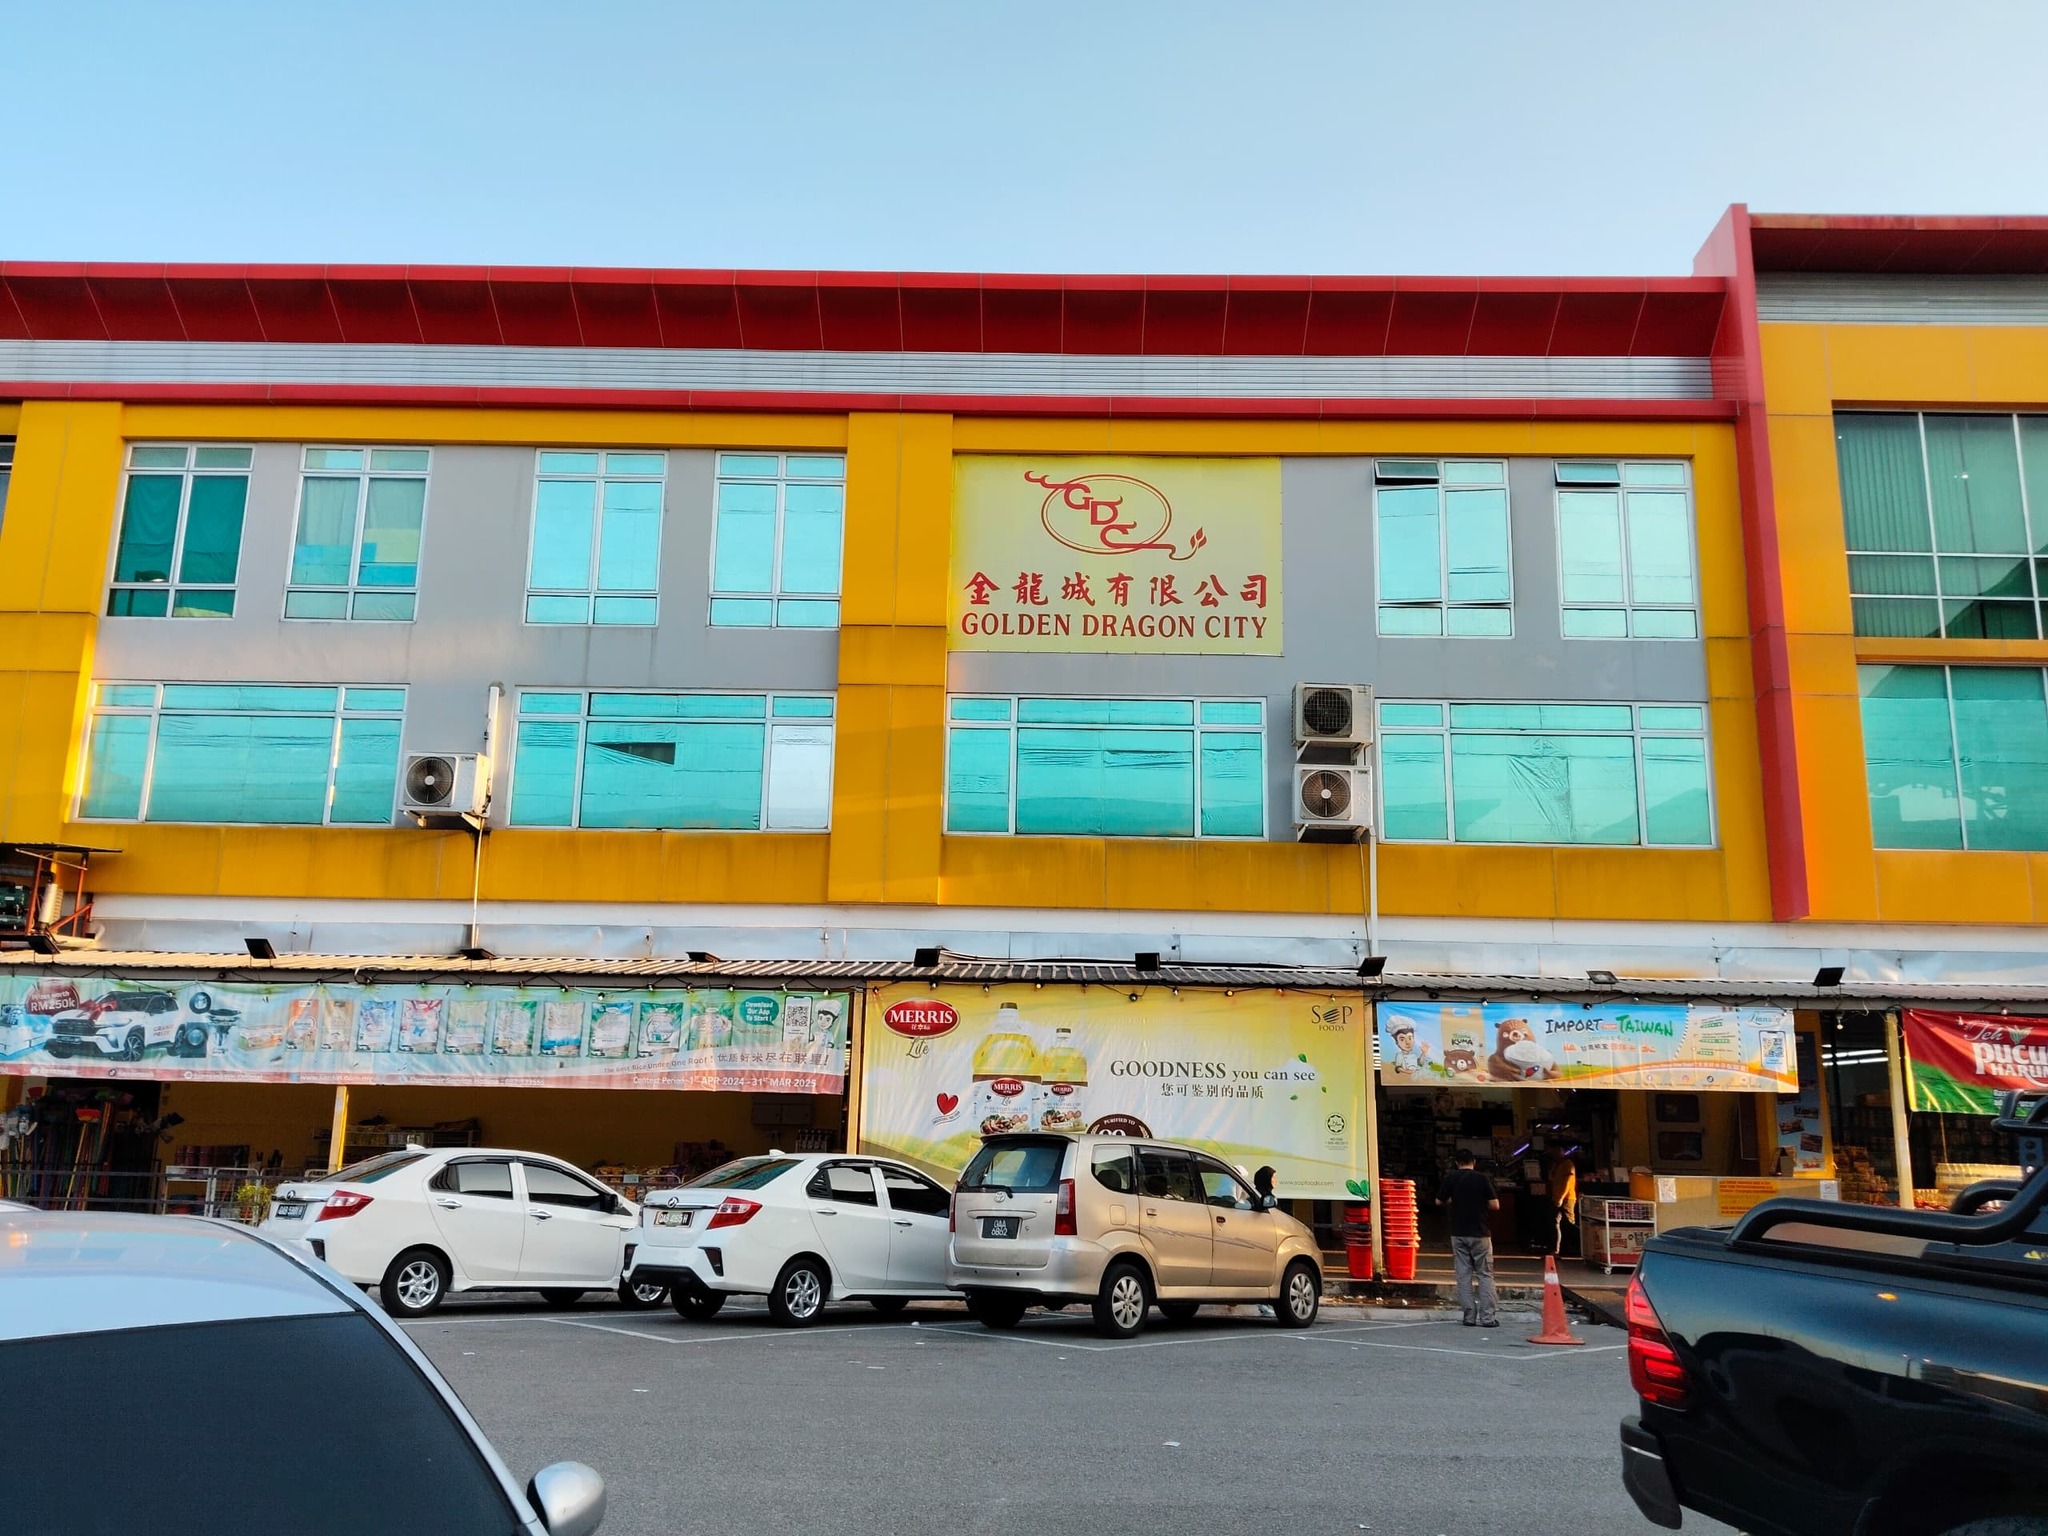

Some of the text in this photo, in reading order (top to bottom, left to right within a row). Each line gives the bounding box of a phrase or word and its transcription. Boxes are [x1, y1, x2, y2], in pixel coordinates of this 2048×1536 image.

[963, 571, 1268, 608] 金龍城有限公司
[961, 612, 1268, 639] GOLDEN DRAGON CITY
[51, 990, 70, 998] worth
[31, 998, 75, 1012] RM250k
[890, 1010, 953, 1024] MERRIS
[1545, 1015, 1674, 1037] IMPORT TAIWAN
[1964, 1024, 2004, 1041] Teh
[688, 1057, 708, 1065] Roof
[1110, 1060, 1316, 1082] GOODNESS you can see
[701, 1077, 721, 1086] APR
[722, 1077, 744, 1086] 2024
[769, 1078, 791, 1087] MAR
[794, 1079, 817, 1087] 2025
[993, 1083, 1022, 1091] MERRIS
[1161, 1083, 1264, 1099] 您可鉴别的品质
